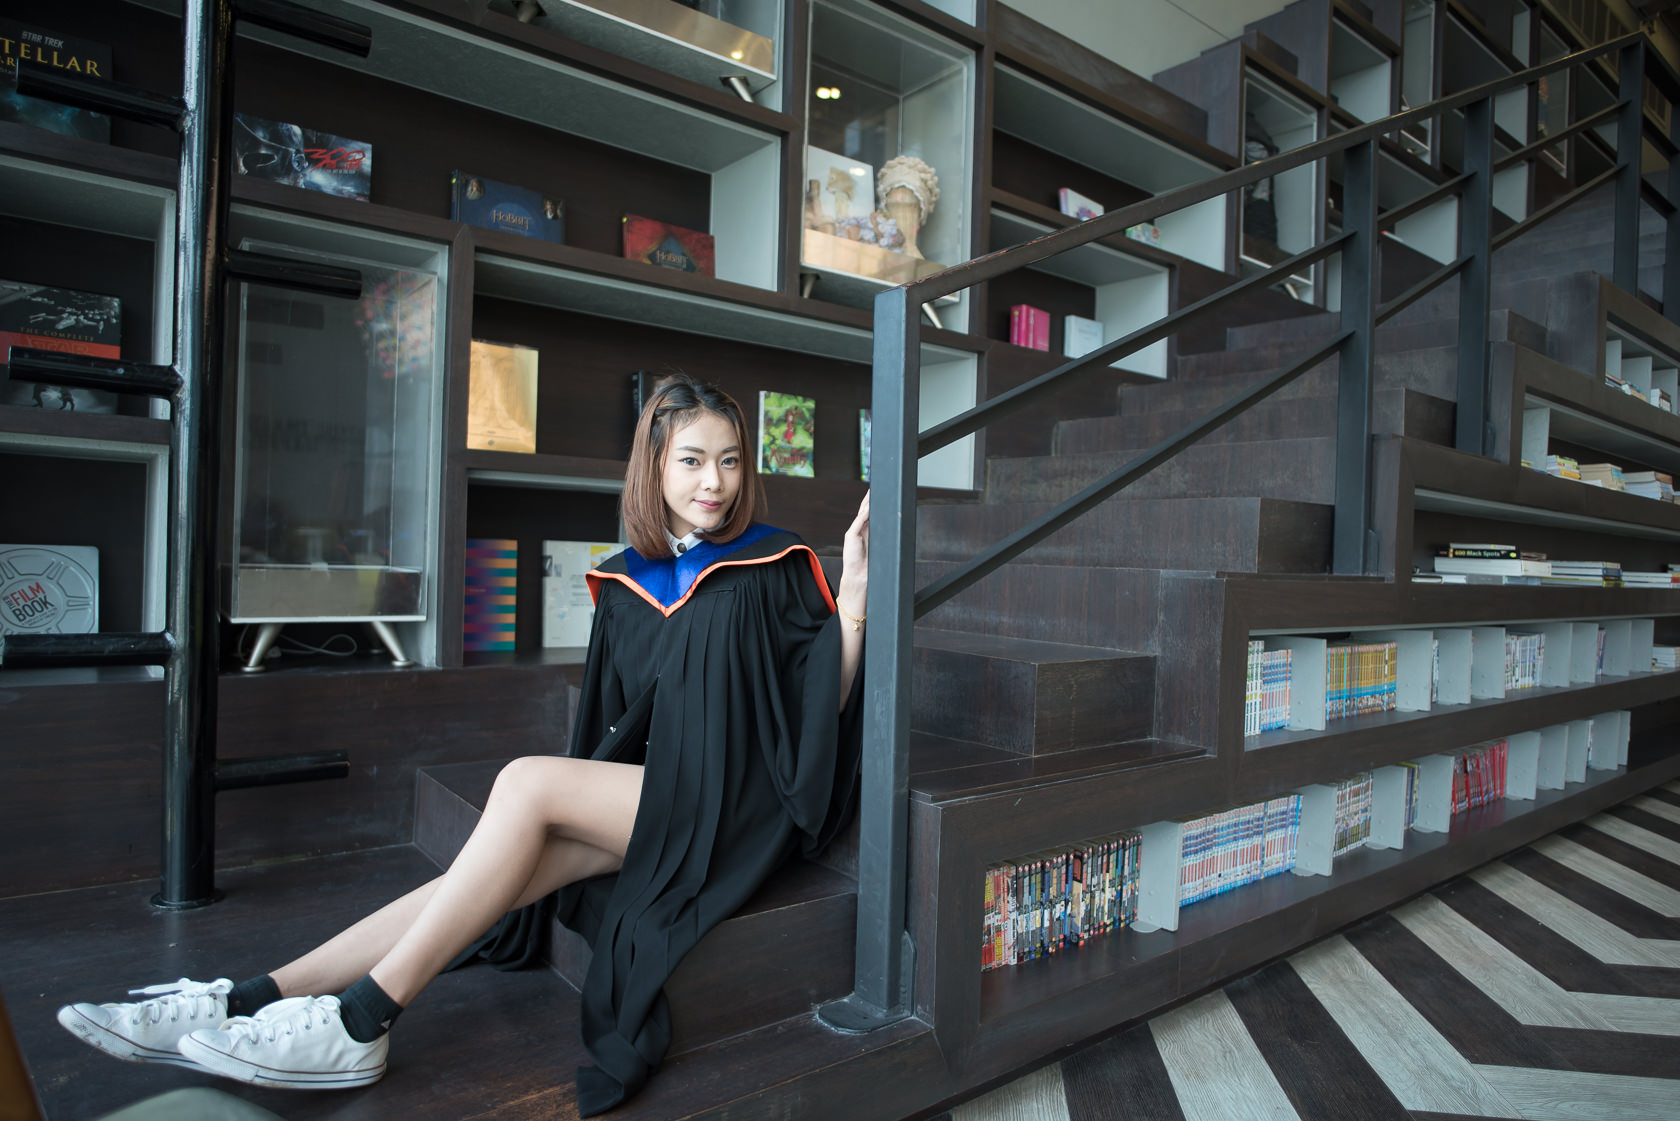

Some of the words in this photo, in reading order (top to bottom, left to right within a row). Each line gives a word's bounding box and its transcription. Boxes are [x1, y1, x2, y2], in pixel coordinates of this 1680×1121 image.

[21, 30, 43, 43] STAR
[44, 36, 65, 48] TREK
[20, 327, 39, 335] THE
[43, 330, 95, 342] COMPLETE
[1466, 549, 1482, 557] Black
[1483, 550, 1500, 559] Spots
[9, 582, 46, 606] FILM
[12, 595, 55, 622] BOOK
